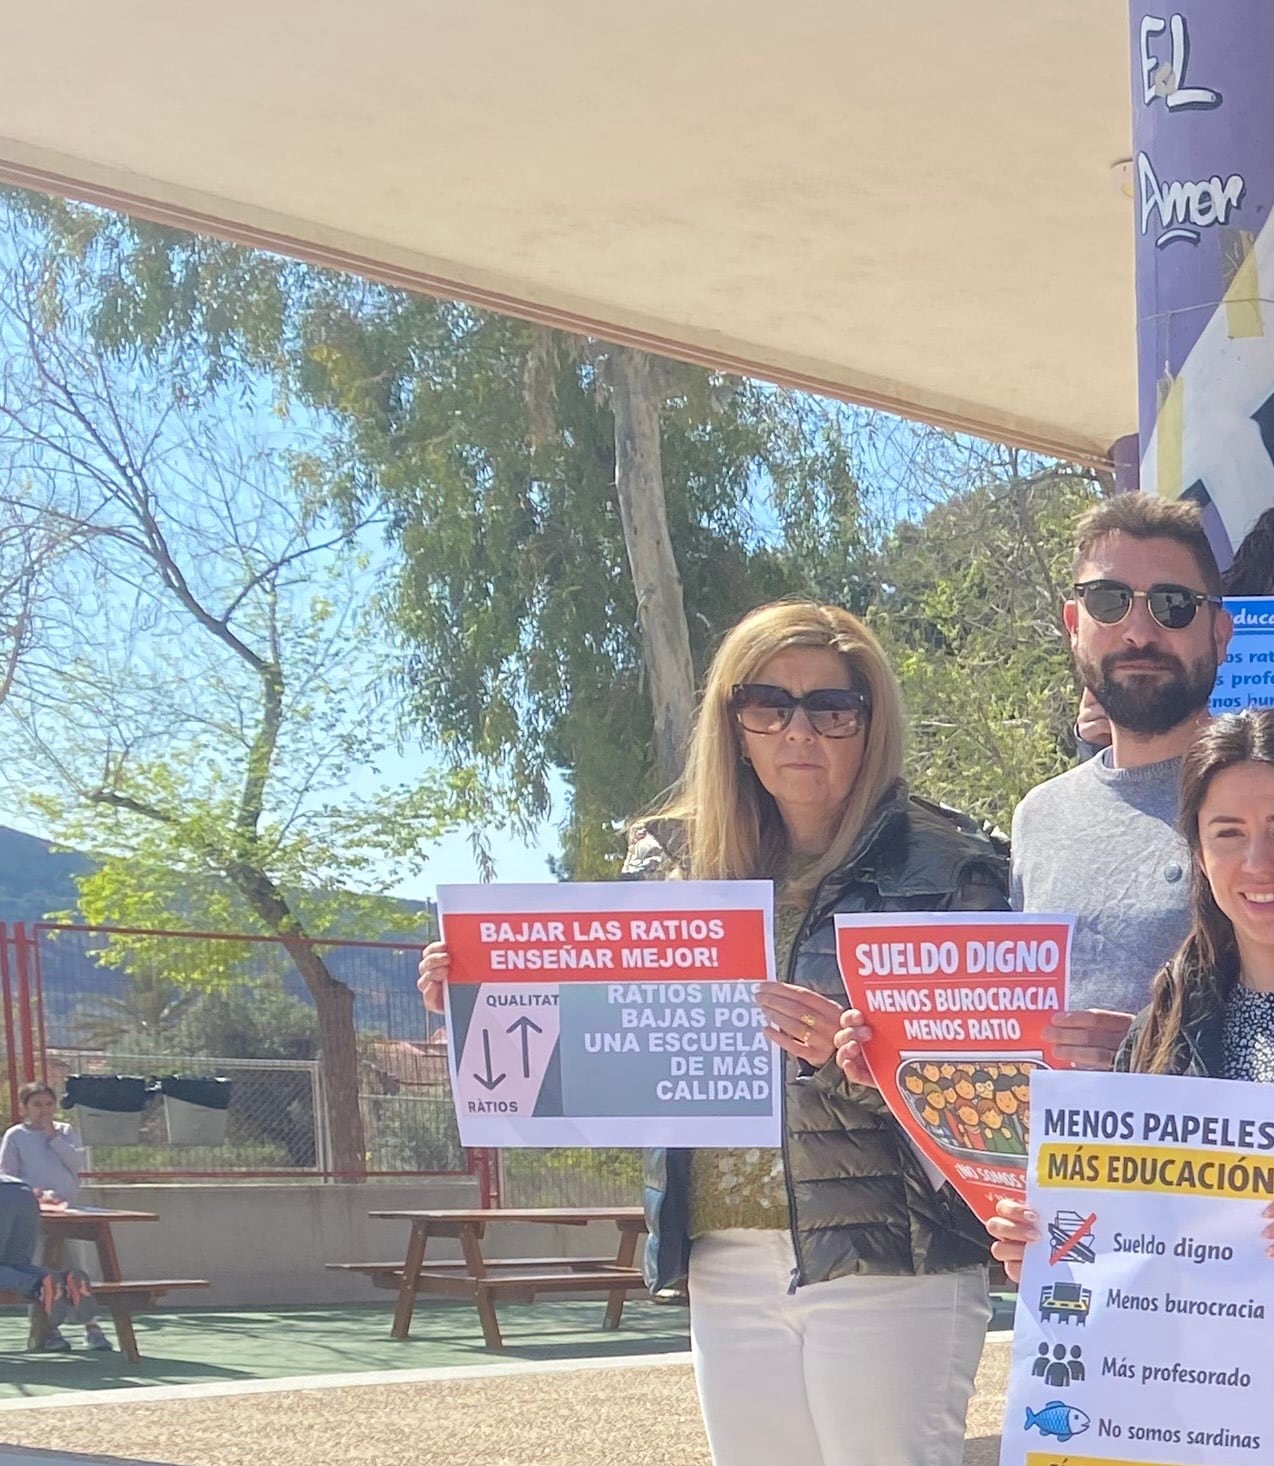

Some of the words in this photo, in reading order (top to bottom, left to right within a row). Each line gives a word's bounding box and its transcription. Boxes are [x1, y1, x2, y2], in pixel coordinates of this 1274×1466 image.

[1140, 13, 1222, 112] EL
[1137, 151, 1245, 235] Amor
[480, 921, 563, 943] BAJAR
[572, 920, 622, 943] LAS
[631, 919, 725, 941] RATIOS
[490, 945, 613, 970] ENSEÑAR
[622, 947, 718, 968] MEJOR!
[855, 941, 959, 976] SUELDO
[966, 940, 1059, 973] DIGNO
[486, 993, 560, 1009] QUALITAT
[608, 984, 702, 1004] RATIOS
[865, 989, 931, 1012] MENOS
[934, 987, 1059, 1012] BUROCRACIA
[622, 1008, 705, 1028] BAJAS
[715, 1007, 768, 1028] POR
[904, 1019, 964, 1040] MENOS
[968, 1018, 1021, 1040] RATIO
[584, 1032, 640, 1052] UNA
[649, 1032, 769, 1052] ESCUELA
[671, 1057, 704, 1076] DE
[713, 1052, 769, 1076] MÁS
[656, 1080, 769, 1100] CALIDAD
[468, 1098, 518, 1113] RÀTIOS
[1044, 1109, 1134, 1140] MENOS
[1047, 1145, 1100, 1182] MÁS
[1113, 1232, 1165, 1255] Sueldo
[1174, 1238, 1233, 1264] digno
[1106, 1288, 1158, 1312] Menos
[1166, 1293, 1265, 1319] burocracia
[1102, 1357, 1135, 1379] Más
[1142, 1363, 1251, 1387] profesorado
[1098, 1419, 1121, 1438] No
[1128, 1424, 1181, 1443] somos
[1187, 1428, 1260, 1449] sardinas
